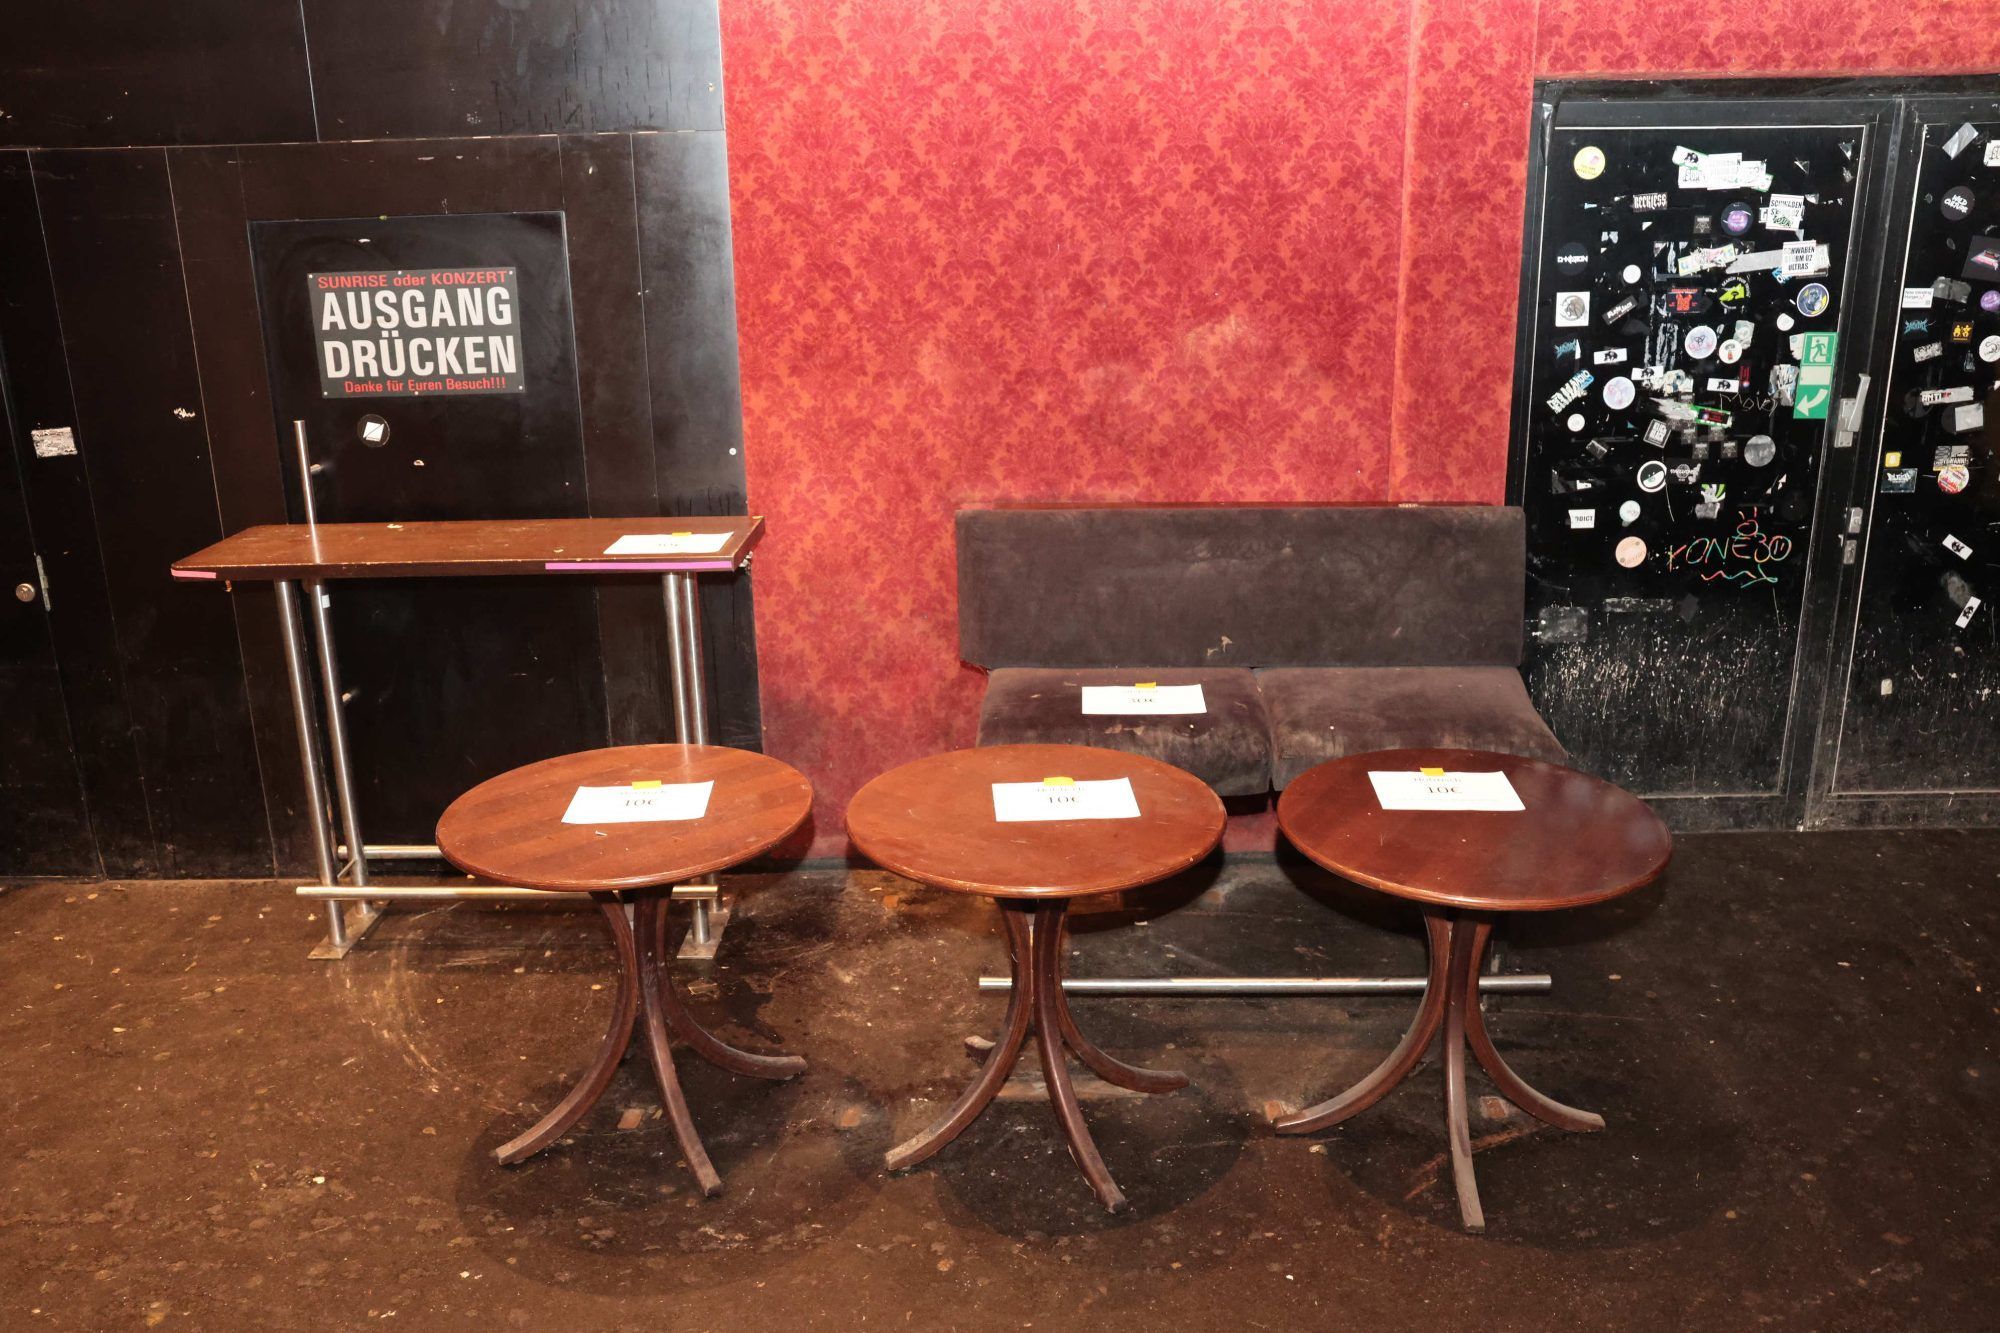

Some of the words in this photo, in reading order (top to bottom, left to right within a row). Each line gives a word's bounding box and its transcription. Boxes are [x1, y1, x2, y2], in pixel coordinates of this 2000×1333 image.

[1788, 263, 1809, 271] ULTRAS
[318, 274, 388, 289] SUNRISE
[393, 274, 426, 287] oder
[431, 271, 507, 285] KONZERT
[321, 286, 512, 330] AUSGANG
[323, 330, 516, 378] DRÜCKEN
[344, 380, 383, 393] Danke
[387, 379, 403, 392] für
[408, 379, 443, 391] Euren
[446, 377, 506, 390] Besuch!!!
